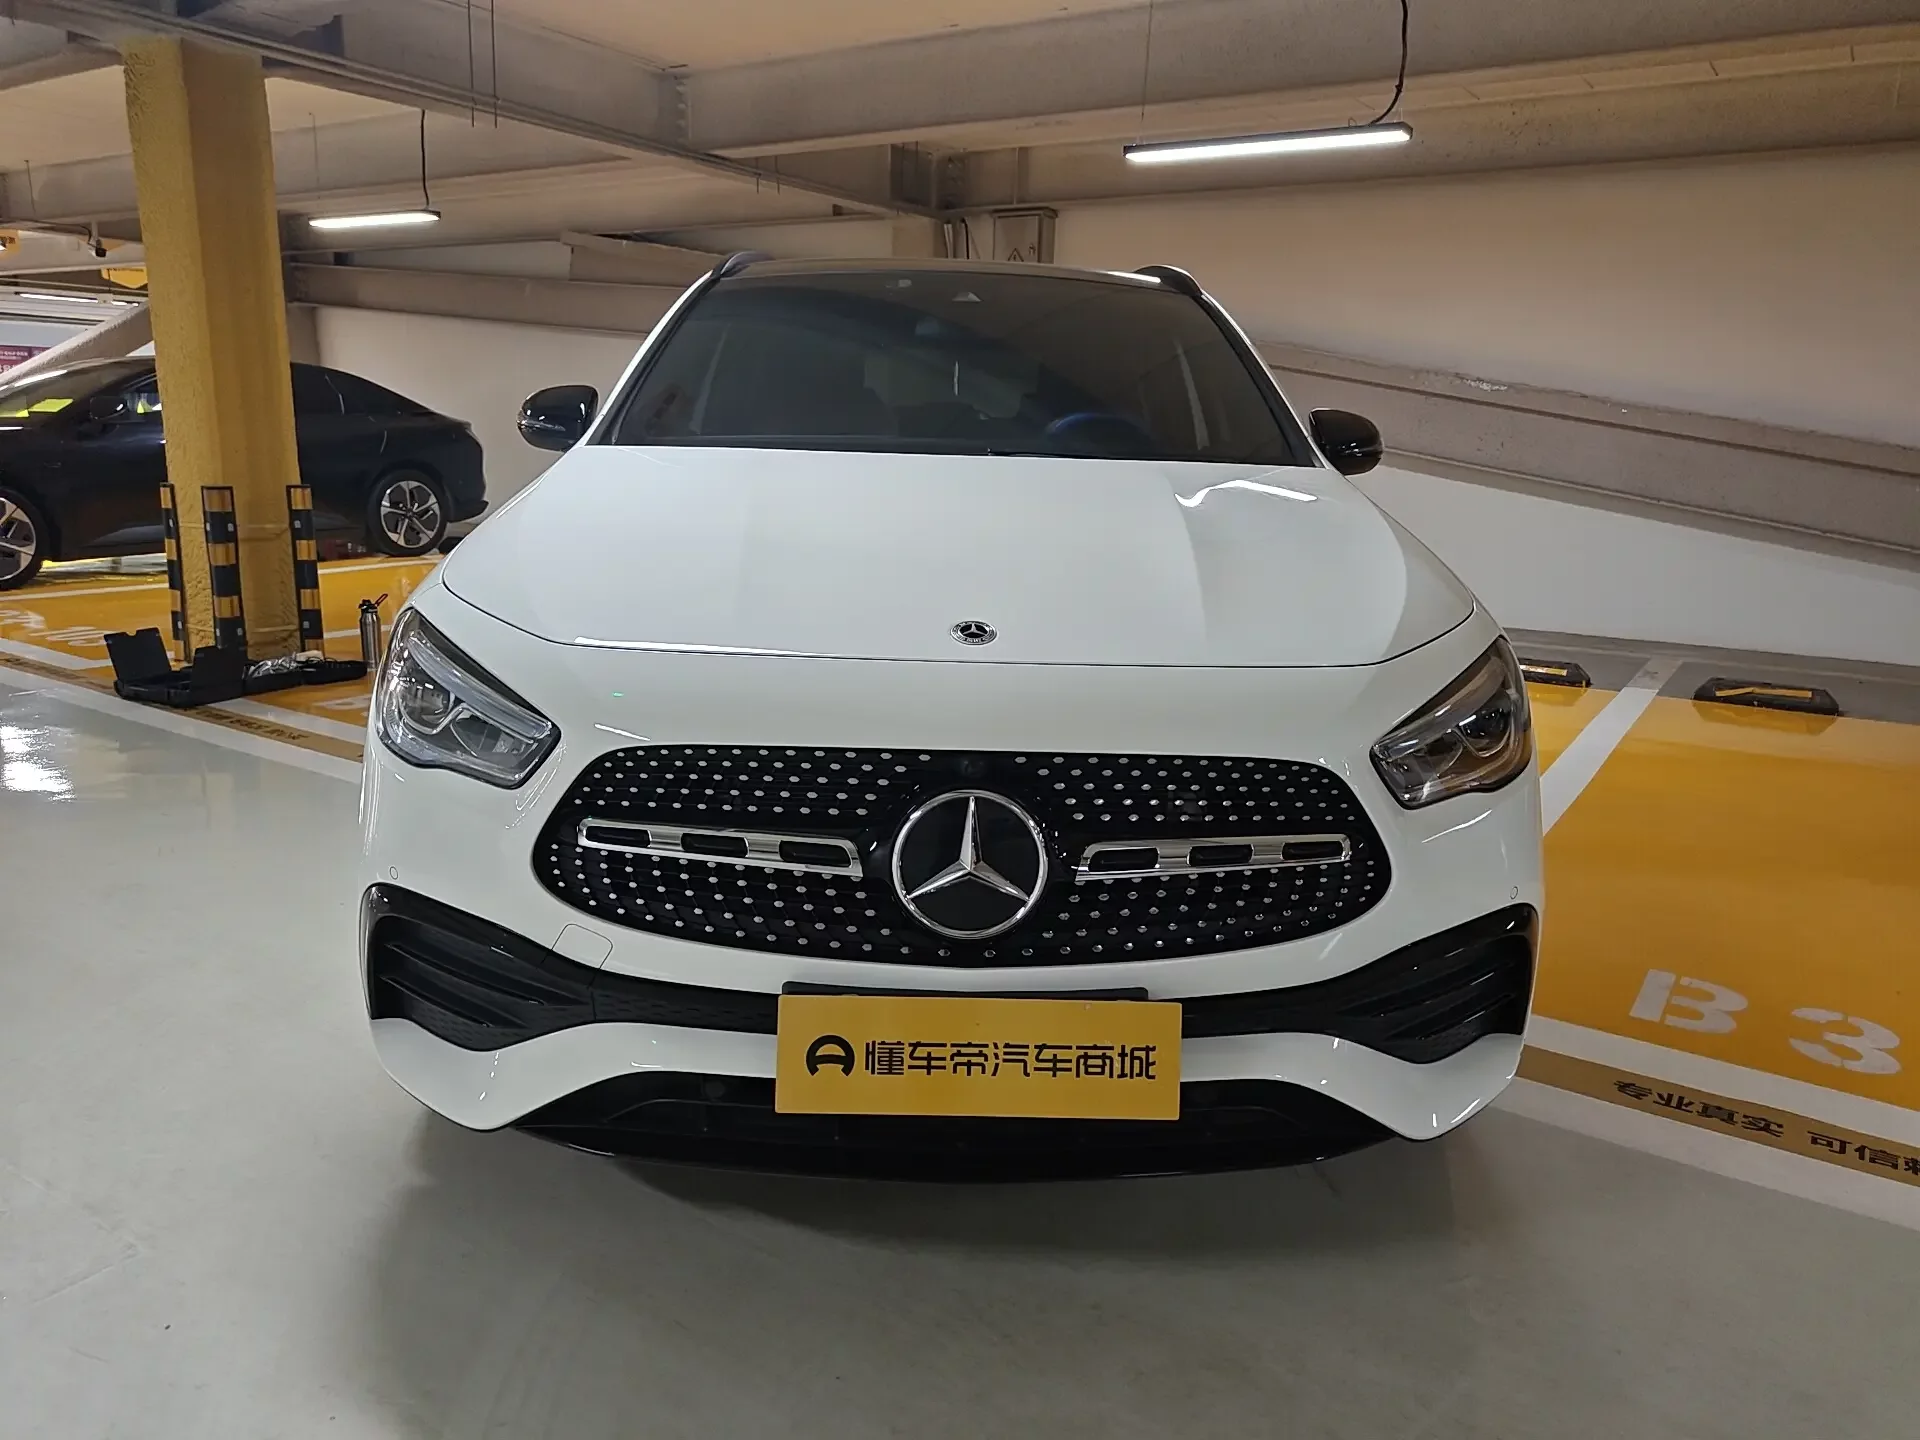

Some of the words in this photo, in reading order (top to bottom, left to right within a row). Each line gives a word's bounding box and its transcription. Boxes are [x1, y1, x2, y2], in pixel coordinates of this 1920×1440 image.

[864, 1040, 1157, 1080] 懂车帝汽车商城
[1613, 1080, 1784, 1138] 专业真实
